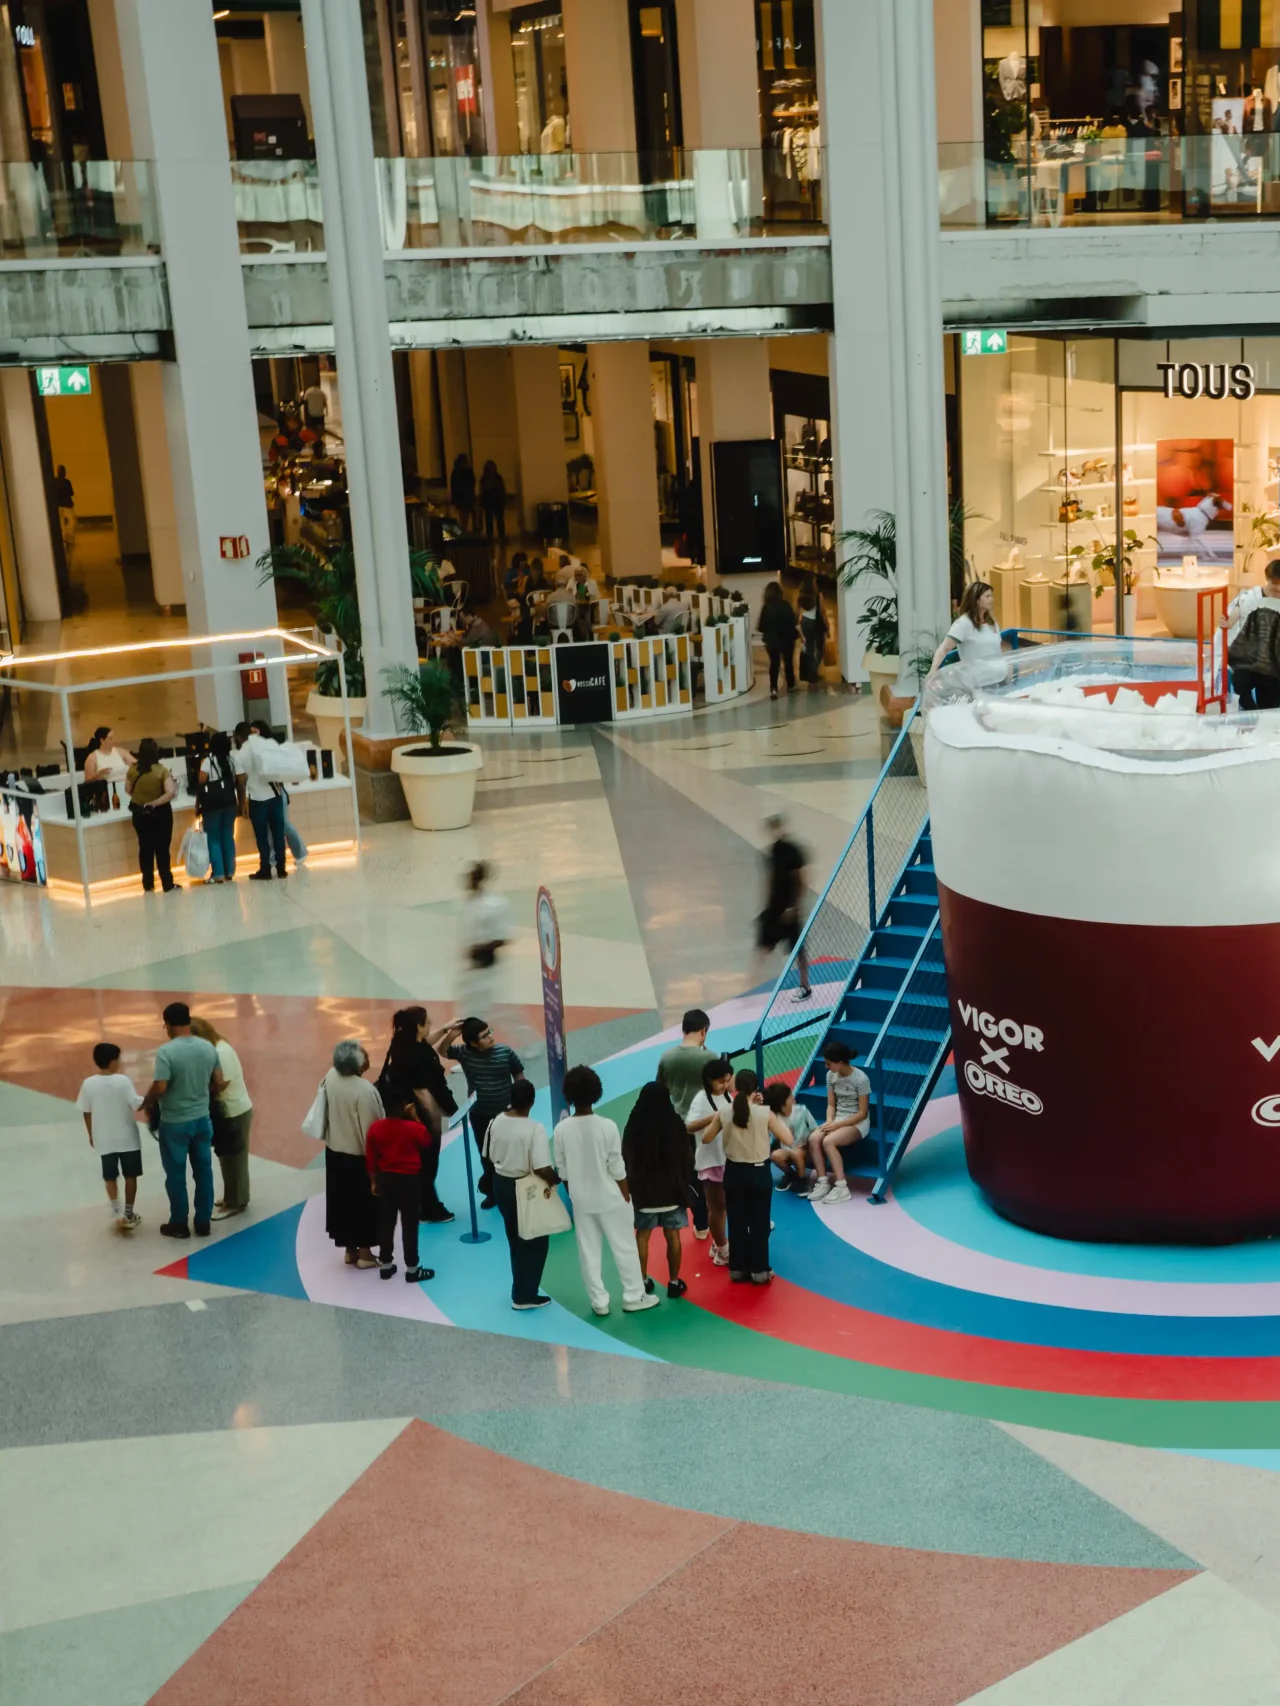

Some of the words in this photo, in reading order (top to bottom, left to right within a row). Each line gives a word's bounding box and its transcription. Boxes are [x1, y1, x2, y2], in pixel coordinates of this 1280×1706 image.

[1157, 361, 1256, 400] TOUS
[957, 999, 1045, 1053] VIGOR
[965, 1062, 1043, 1114] OREO
